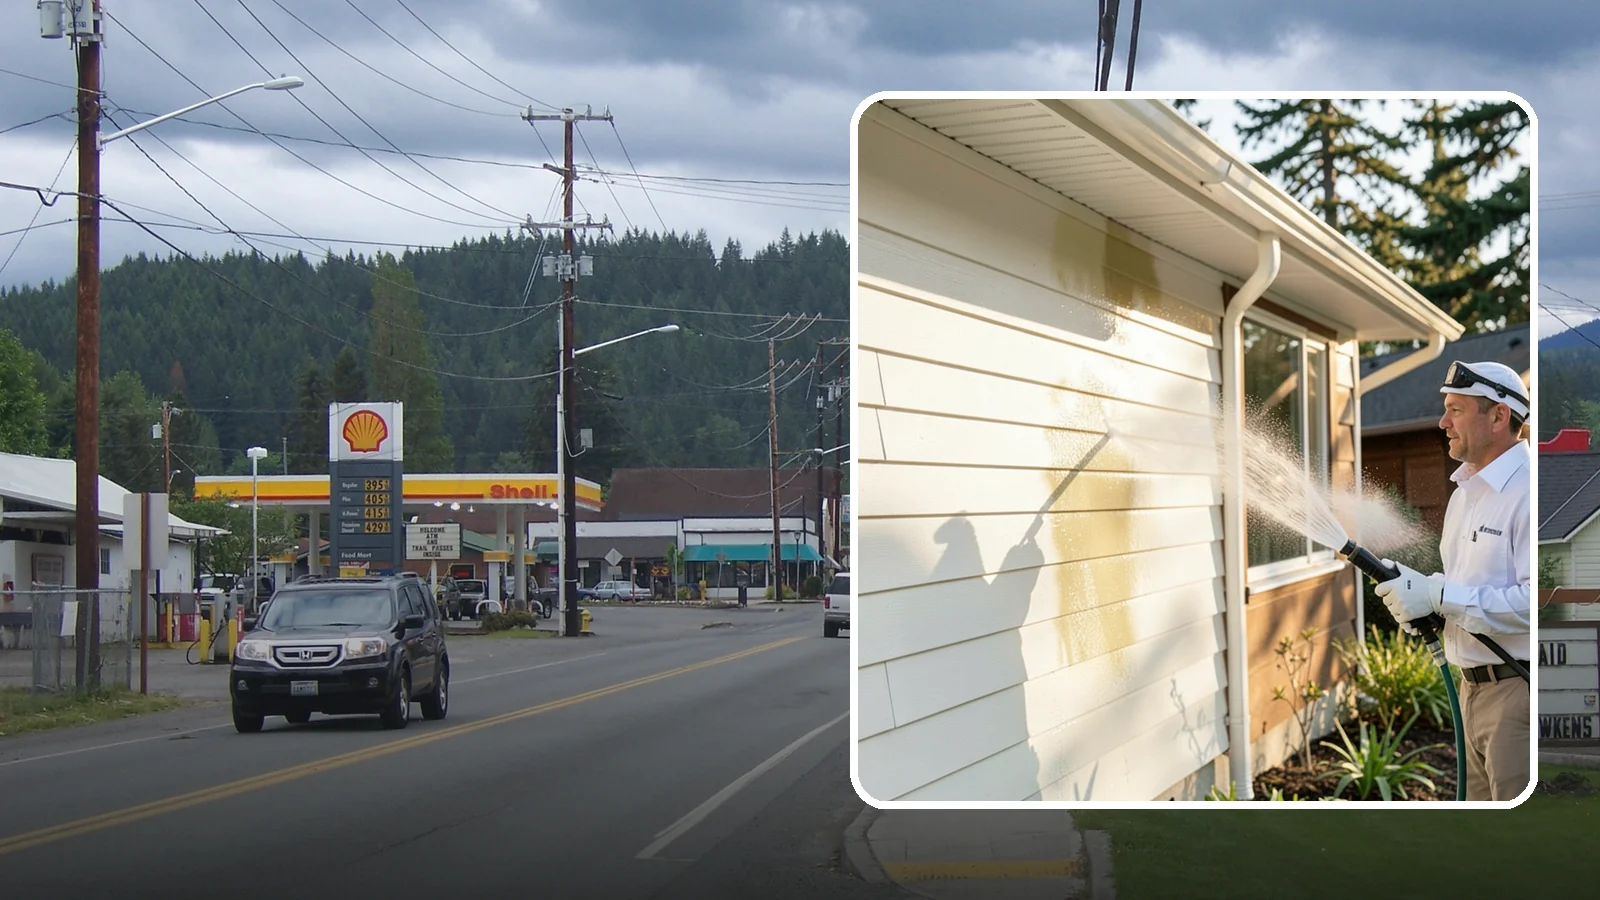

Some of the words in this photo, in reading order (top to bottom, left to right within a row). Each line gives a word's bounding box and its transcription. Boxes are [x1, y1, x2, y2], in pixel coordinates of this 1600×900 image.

[365, 480, 384, 490] 395
[490, 484, 547, 499] Shell
[365, 494, 384, 504] 405
[365, 508, 384, 518] 415
[365, 522, 384, 532] 429
[1538, 642, 1567, 666] AID
